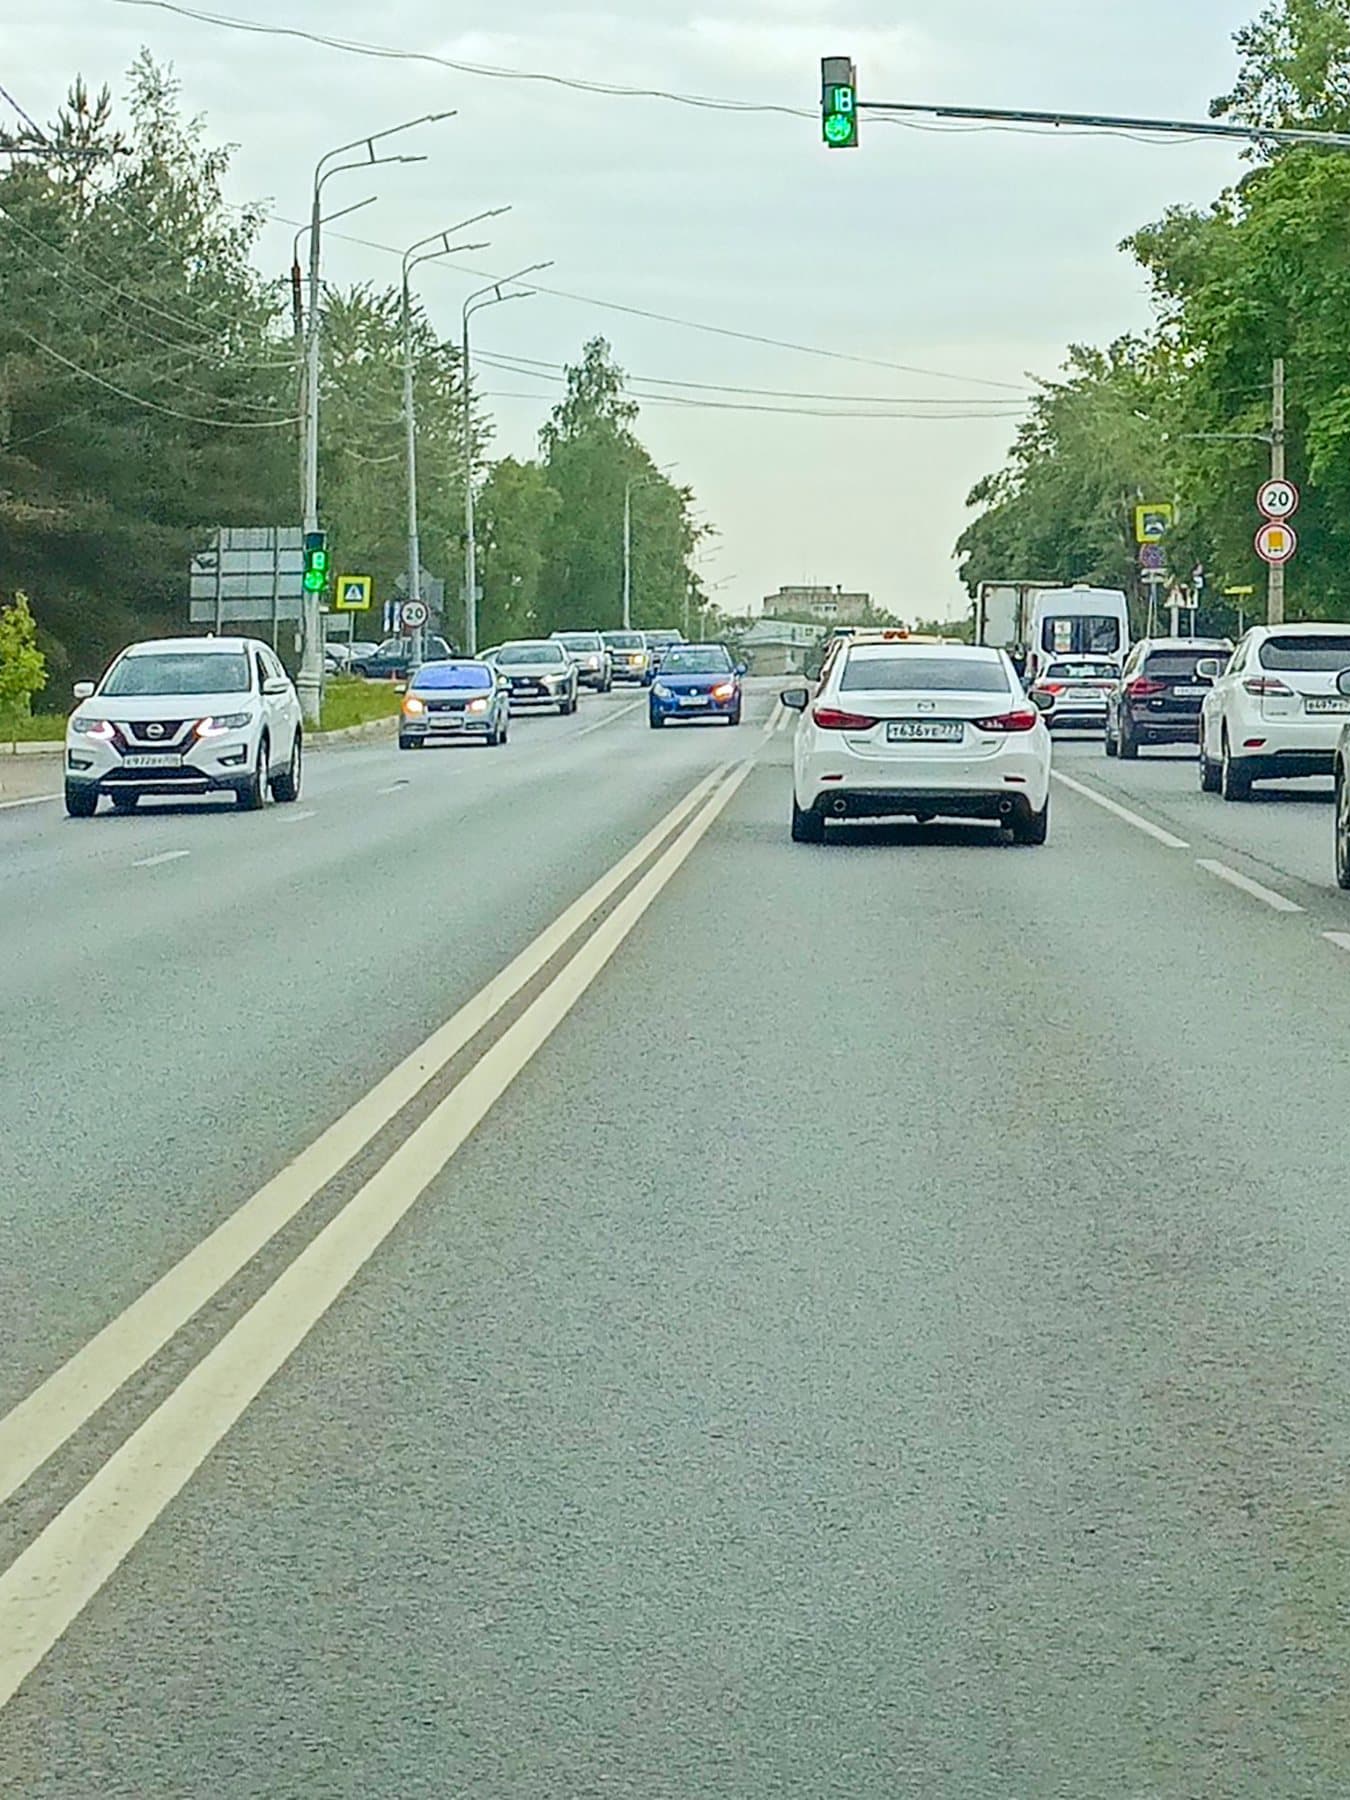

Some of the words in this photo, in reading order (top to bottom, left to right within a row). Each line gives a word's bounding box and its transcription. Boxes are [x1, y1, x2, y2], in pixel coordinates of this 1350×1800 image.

[835, 87, 852, 111] 18
[1267, 490, 1289, 507] 20
[405, 607, 424, 620] 20
